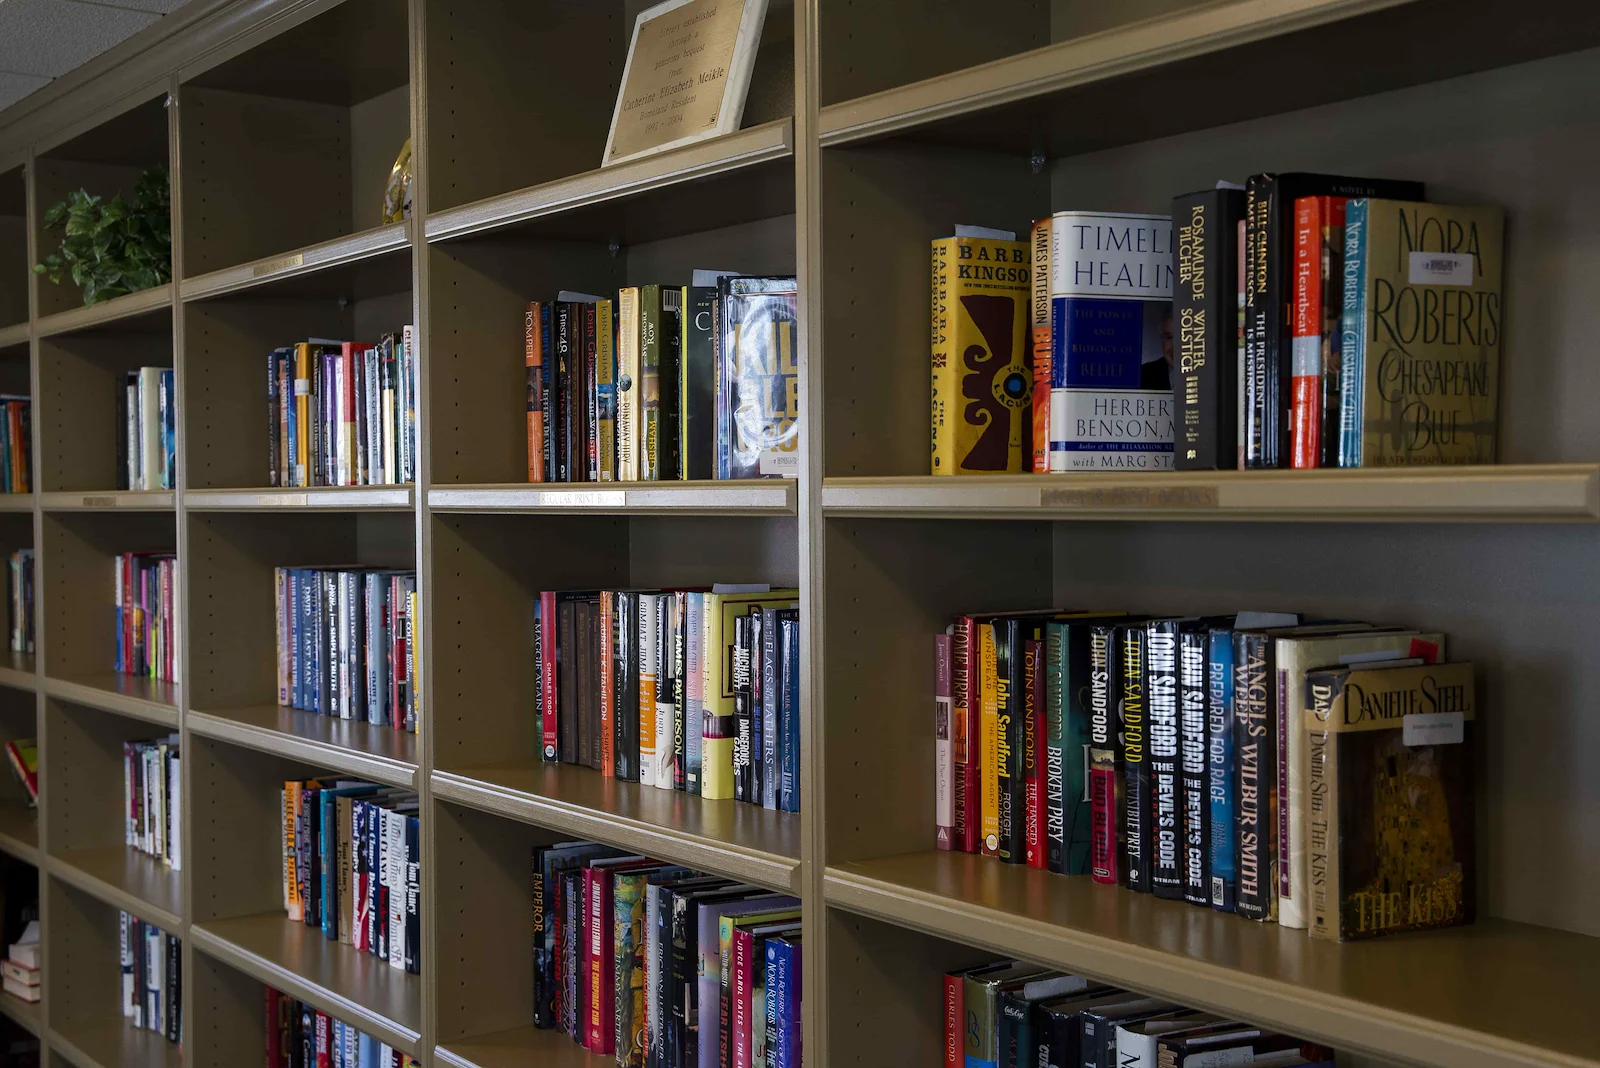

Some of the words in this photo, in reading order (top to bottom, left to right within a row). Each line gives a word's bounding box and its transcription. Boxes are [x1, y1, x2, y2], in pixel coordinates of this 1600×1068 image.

[683, 7, 717, 28] established
[654, 53, 681, 70] generous
[683, 43, 706, 62] bequest
[669, 33, 692, 49] through
[624, 91, 655, 112] Catherine
[659, 78, 694, 98] Elizabeth
[698, 66, 724, 86] Meikle
[669, 67, 683, 79] from
[640, 104, 668, 120] Homeland
[671, 94, 697, 110] Resident
[1247, 190, 1255, 230] JAMES
[1258, 200, 1268, 227] BILL
[1036, 226, 1048, 263] JAMES
[1179, 227, 1192, 284] PILCHER
[1192, 206, 1205, 301] ROSAMUNDE
[1299, 228, 1310, 246] In
[1345, 220, 1362, 256] NORA
[1398, 208, 1484, 277] NORA
[1247, 233, 1255, 307] PATTERSON
[1257, 231, 1267, 293] CLINTON
[931, 246, 939, 347] KINGSOLVER
[939, 245, 948, 346] BARBARA
[1036, 266, 1048, 325] PATTERSON
[1074, 308, 1097, 319] THE
[1098, 308, 1134, 320] POWER
[1297, 262, 1310, 334] Heartbeat
[525, 310, 534, 359] POMPEII
[601, 305, 609, 331] JOHN
[1092, 326, 1116, 337] AND
[1255, 310, 1266, 339] THE
[1372, 278, 1499, 357] ROBERTS
[404, 330, 412, 357] CLIVE
[1181, 309, 1194, 374] SOLSTICE
[1192, 310, 1206, 369] WINTER
[1080, 361, 1126, 378] BELIEF
[1255, 341, 1266, 409] PRESIDENT
[1378, 349, 1490, 403] CHESAPEAKE
[931, 374, 939, 453] LACUNA
[1400, 401, 1461, 451] BLUE
[648, 420, 656, 471] GRISHAM
[1073, 458, 1094, 468] with
[1100, 455, 1147, 467] MARG
[1078, 443, 1097, 451] Author
[1121, 444, 1162, 452] RELAXATION
[575, 493, 594, 504] PRINT
[304, 586, 312, 616] DAVID
[304, 632, 312, 659] LAST
[674, 634, 684, 675] JAMES
[765, 641, 775, 682] FLAGS
[953, 623, 970, 664] HOME
[984, 630, 993, 691] WINSPEAR
[1047, 630, 1061, 670] JOHN
[1091, 632, 1107, 671] JOHN
[1122, 638, 1142, 680] JOHN
[1146, 625, 1177, 673] JOHN
[304, 660, 312, 685] MAN
[740, 648, 749, 688] MICHAEL
[1024, 650, 1035, 689] JOHN
[1180, 643, 1204, 688] JOHN
[954, 669, 970, 708] FIRES
[997, 675, 1012, 709] John
[1048, 672, 1063, 741] SANDFORD
[1091, 671, 1107, 744] SANDFORD
[1207, 661, 1225, 733] PREPARED
[1234, 663, 1250, 725] WEEP
[1247, 655, 1269, 738] ANGELS
[1343, 683, 1418, 726] DANIELLE
[1417, 675, 1470, 713] STEEL
[674, 678, 684, 755] PATTERSON
[765, 702, 775, 765] FATHERS
[1024, 693, 1036, 770] SANDFORD
[1123, 683, 1143, 763] SANDFORD
[1147, 675, 1178, 757] SANDFORD
[1181, 690, 1206, 775] SANDFORD
[733, 737, 741, 776] GAMES
[739, 718, 750, 767] DANGEROUS
[996, 713, 1012, 779] Sandford
[1209, 737, 1225, 764] FOR
[1309, 732, 1326, 781] DANIELLE
[955, 762, 967, 806] LUANNE
[1047, 746, 1064, 802] BROKEN
[1151, 762, 1175, 773] THE
[1182, 778, 1203, 789] THE
[1209, 768, 1226, 805] RAGE
[1238, 743, 1259, 827] WILBUR
[286, 800, 296, 817] LEE
[1027, 782, 1038, 807] THE
[1094, 775, 1108, 808] BAD
[1157, 774, 1176, 828] DEVIL'S
[1310, 780, 1329, 816] STEEL
[286, 818, 296, 843] CHILD
[367, 808, 377, 830] Tom
[379, 813, 389, 838] TOM
[955, 809, 967, 835] RICE
[1002, 791, 1012, 837] ROUGH
[1027, 808, 1038, 846] HANGED
[1047, 804, 1064, 843] PREY
[1187, 789, 1204, 844] DEVIL'S
[341, 840, 350, 861] Tom
[367, 832, 377, 869] Clancy
[1094, 810, 1108, 864] BLOOD
[1126, 832, 1141, 860] PREY
[1157, 830, 1176, 871] CODE
[1219, 821, 1229, 848] DANA
[1312, 820, 1328, 850] THE
[286, 861, 296, 901] PERSONAL
[341, 861, 350, 895] Clancy
[379, 841, 389, 885] CLANCY
[407, 861, 420, 882] Tom
[1187, 846, 1204, 890] CODE
[1238, 830, 1259, 898] SMITH
[1311, 851, 1328, 887] KISS
[367, 871, 377, 898] Debt
[368, 899, 377, 909] of
[407, 881, 420, 916] Clancy
[532, 872, 543, 933] EMPEROR
[591, 880, 601, 916] JONATHAN
[389, 887, 402, 944] Rainbow
[1352, 891, 1402, 932] THE
[1407, 884, 1458, 926] KISS
[367, 910, 377, 946] Honor
[591, 917, 601, 956] KELLERMAN
[591, 960, 600, 972] THE
[736, 940, 745, 966] JOYCE
[777, 956, 787, 982] NORA
[591, 972, 600, 1009] CONSPIRACY
[736, 969, 745, 995] CAROL
[766, 962, 776, 987] NORA
[736, 999, 745, 1026] OATES
[766, 988, 776, 1025] ROBERTS
[777, 981, 786, 1014] ROBERTS
[948, 984, 957, 1029] CHARLES
[591, 1010, 600, 1026] CLUB
[777, 1028, 787, 1043] KEY
[737, 1042, 745, 1057] THE
[766, 1048, 776, 1066] THE
[948, 1032, 957, 1063] TODD
